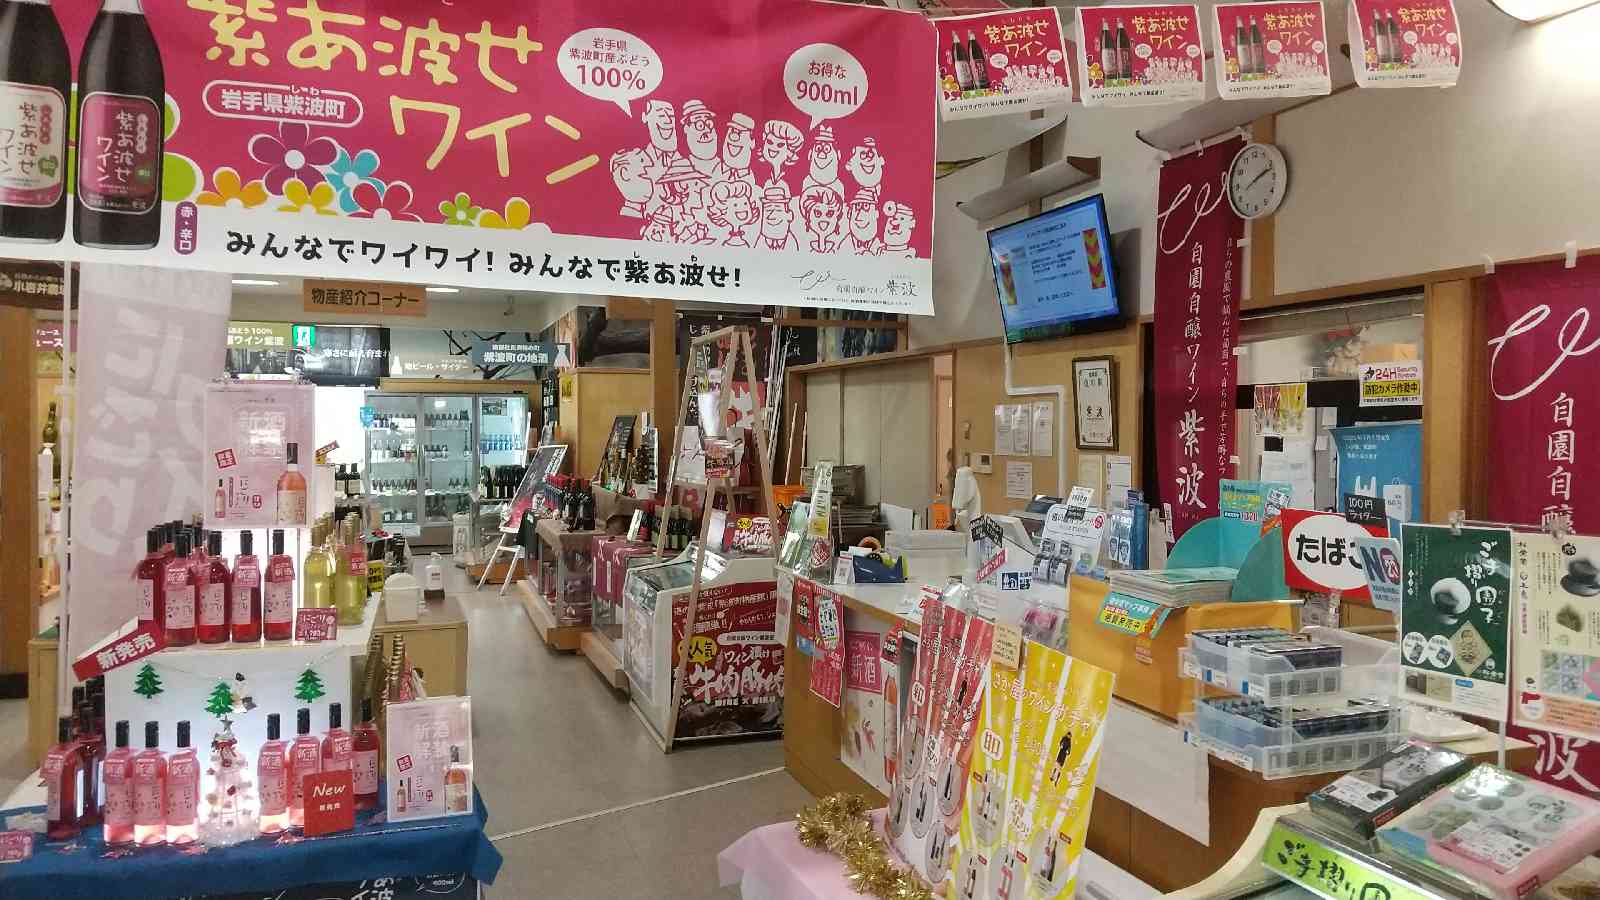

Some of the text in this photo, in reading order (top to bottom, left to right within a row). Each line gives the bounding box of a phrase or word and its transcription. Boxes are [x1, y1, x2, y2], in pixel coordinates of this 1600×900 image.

[984, 20, 1049, 44] 紫あ波せ
[1149, 34, 1188, 50] ワイン
[1280, 31, 1314, 46] ワイン
[592, 37, 628, 50] 岩手県
[1004, 41, 1048, 58] ワイン
[569, 47, 650, 67] 紫波町産ぶどう
[576, 64, 646, 91] 100%
[808, 61, 847, 80] お得な
[221, 88, 346, 120] 岩手県紫波町
[796, 81, 859, 106] 900ml
[389, 95, 600, 184] ワイン
[97, 136, 112, 182] ワイン
[226, 231, 495, 273] みんなでワイワイ!
[509, 250, 740, 288] みんなで紫あ波せ!
[311, 288, 420, 309] 物産紹介コーナー
[1375, 368, 1397, 380] 24H
[1364, 383, 1418, 395] 防犯カメラ作動中
[1176, 408, 1207, 509] 紫波
[1348, 497, 1373, 511] 100円
[96, 632, 156, 669] 新発売
[312, 783, 346, 799] New
